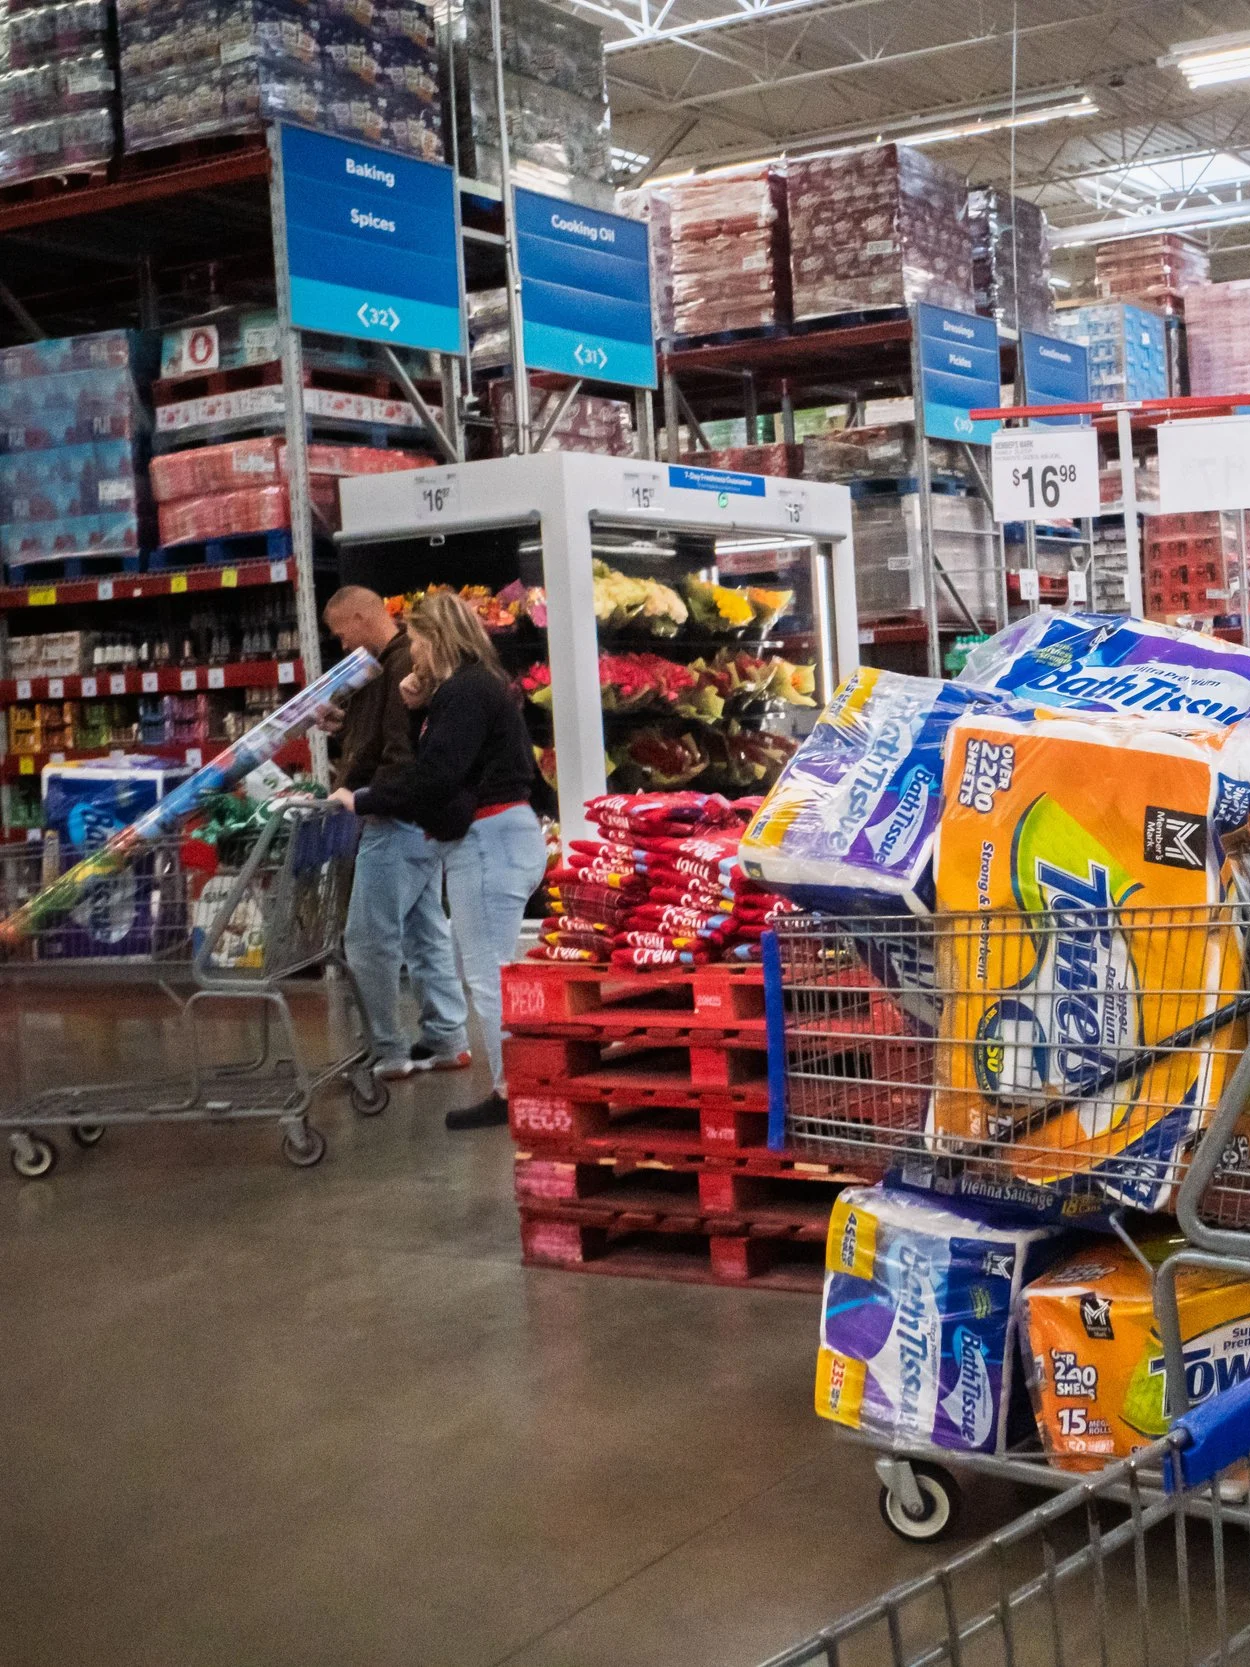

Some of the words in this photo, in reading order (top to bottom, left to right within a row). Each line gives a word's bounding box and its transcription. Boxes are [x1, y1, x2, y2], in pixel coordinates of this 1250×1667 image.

[345, 158, 395, 188] Baking
[350, 208, 396, 232] Spices
[551, 214, 598, 241] Cooking
[599, 227, 615, 243] Oil
[369, 307, 390, 327] 32
[1134, 664, 1165, 677] Ultra
[1165, 671, 1221, 687] Premium
[959, 740, 979, 806] SHEETS
[974, 741, 1000, 813] 2200
[1000, 743, 1014, 790] OVER
[1214, 779, 1237, 823] THICK
[1147, 821, 1156, 848] Mark
[1154, 811, 1166, 861] Member's
[977, 841, 993, 892] Strong
[979, 892, 991, 905] &
[633, 949, 677, 964] Crew
[959, 1179, 1002, 1199] Vienna
[1004, 1184, 1054, 1211] Sausage
[831, 1358, 846, 1388] 235
[1058, 1408, 1087, 1435] 15
